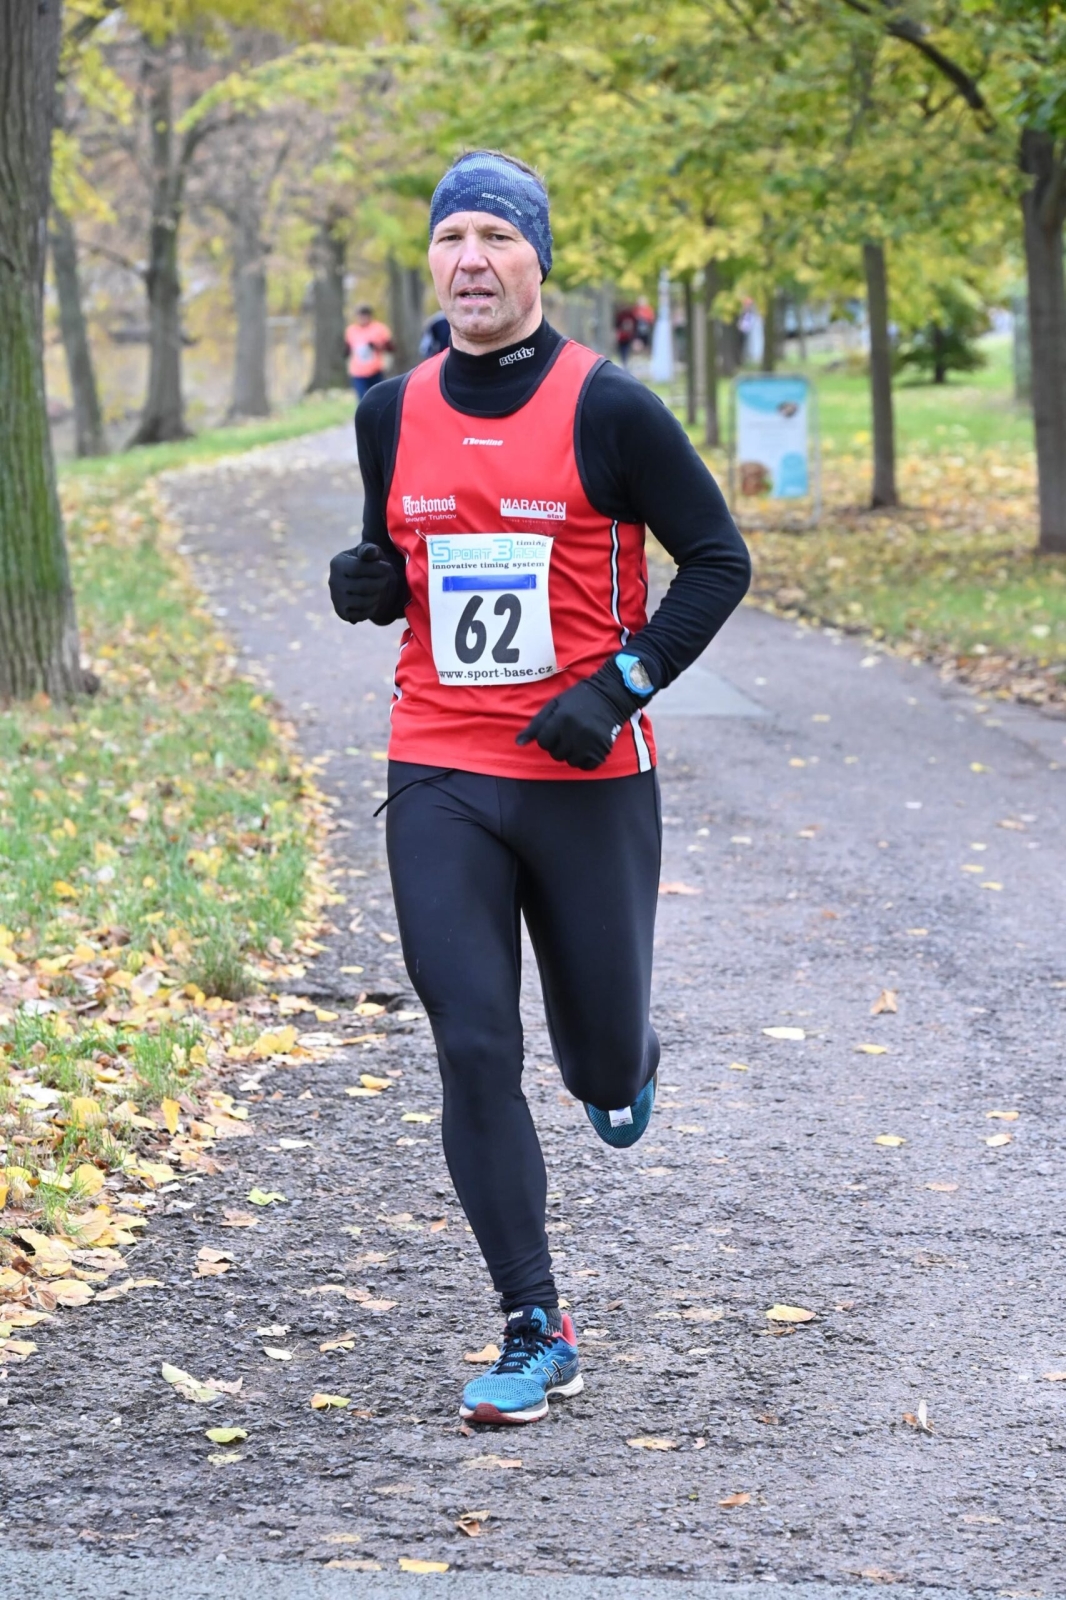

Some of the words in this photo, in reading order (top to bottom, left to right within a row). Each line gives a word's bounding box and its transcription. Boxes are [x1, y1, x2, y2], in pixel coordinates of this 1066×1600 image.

[402, 495, 456, 516] Krakonoš
[500, 498, 566, 513] MARATON
[432, 562, 478, 570] innovative
[480, 562, 510, 570] timing
[512, 561, 545, 569] system
[454, 593, 522, 664] 62
[439, 665, 554, 681] www.sport-base.cz
